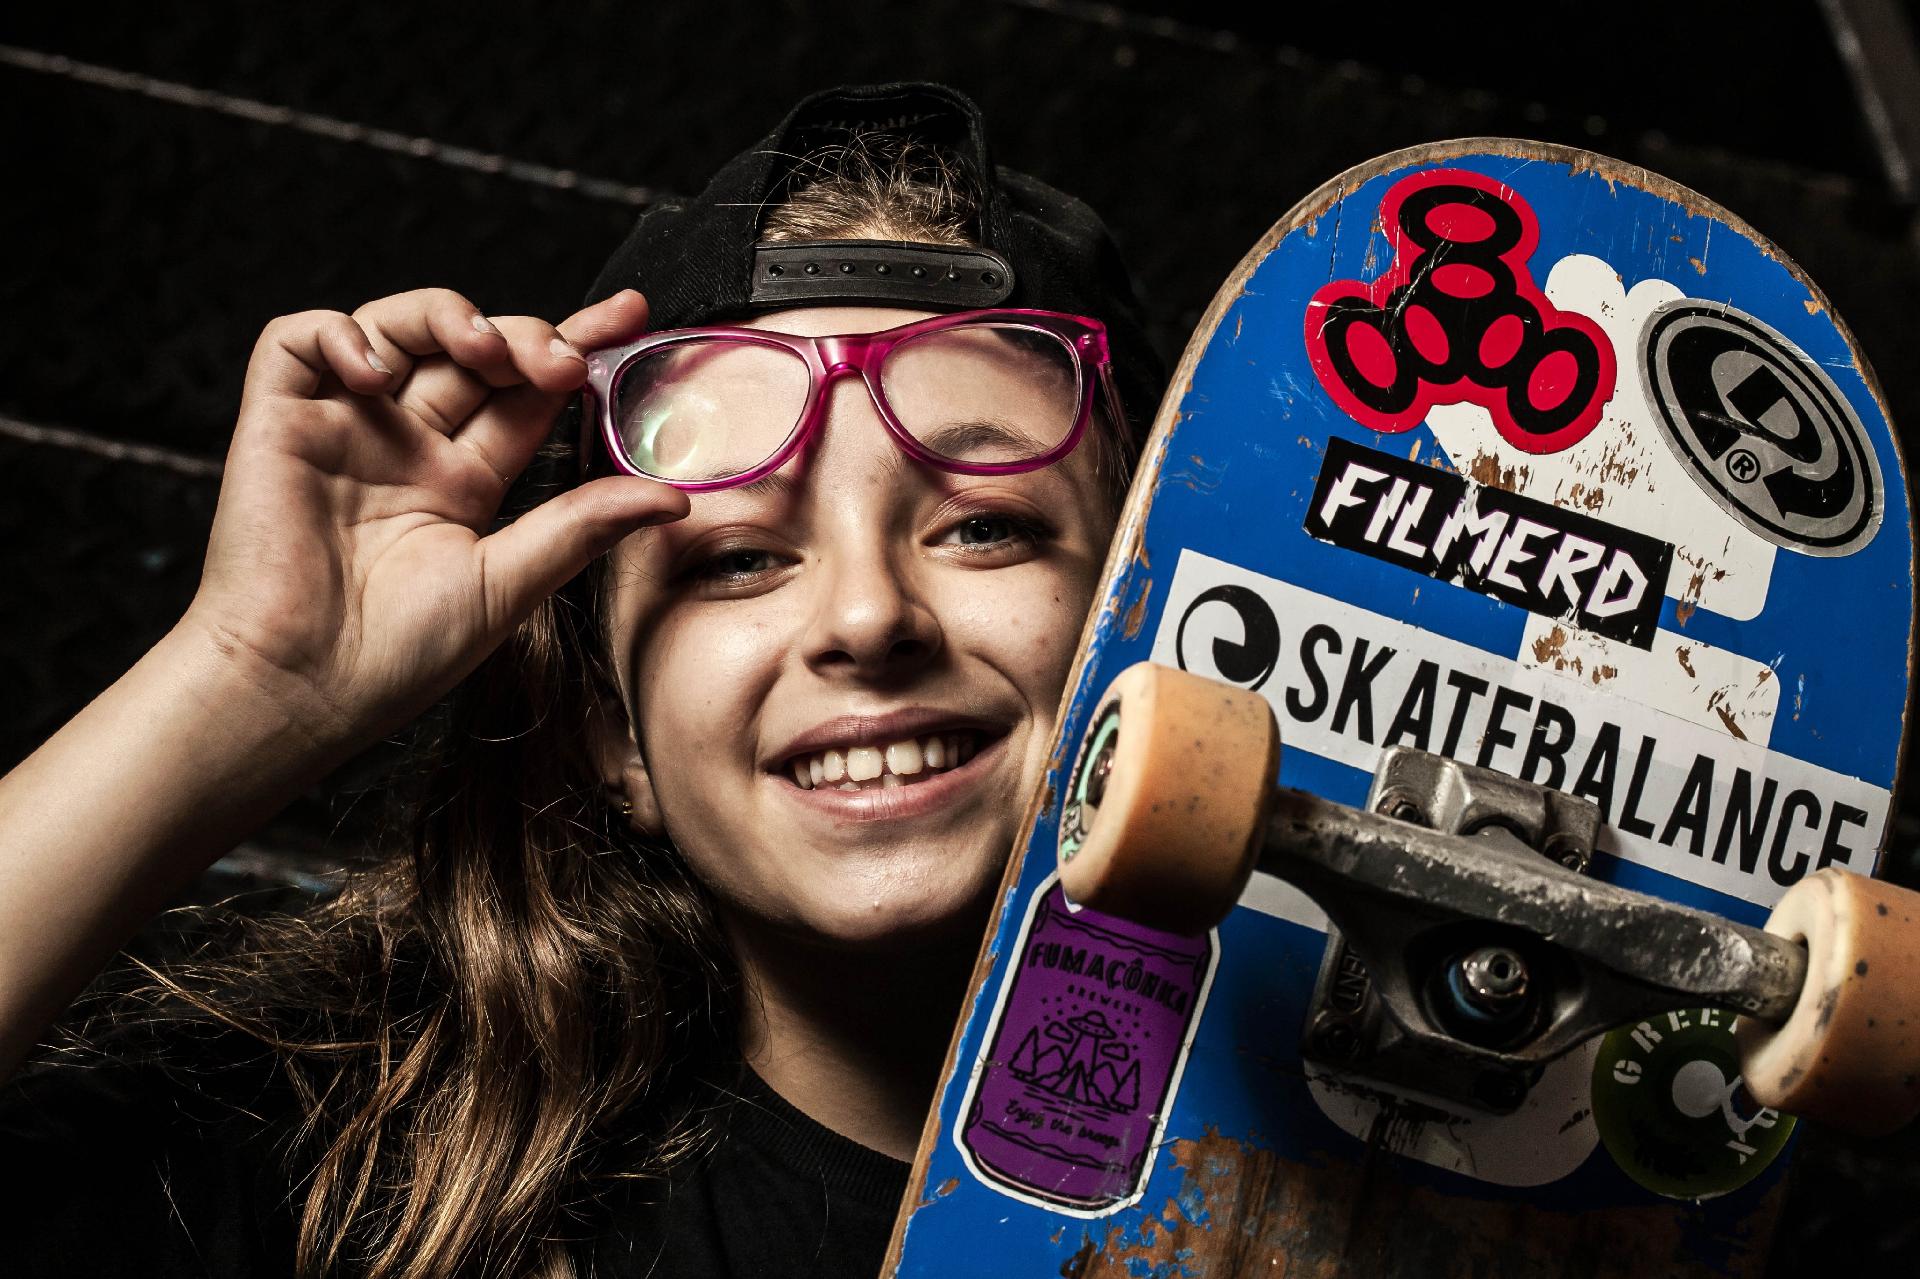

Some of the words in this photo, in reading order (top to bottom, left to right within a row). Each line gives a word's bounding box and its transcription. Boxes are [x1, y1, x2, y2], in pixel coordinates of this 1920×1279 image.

[1319, 460, 1650, 618] FILMERD
[1285, 622, 1869, 888] SKATEBALANCE
[1612, 1007, 1738, 1085] GREE
